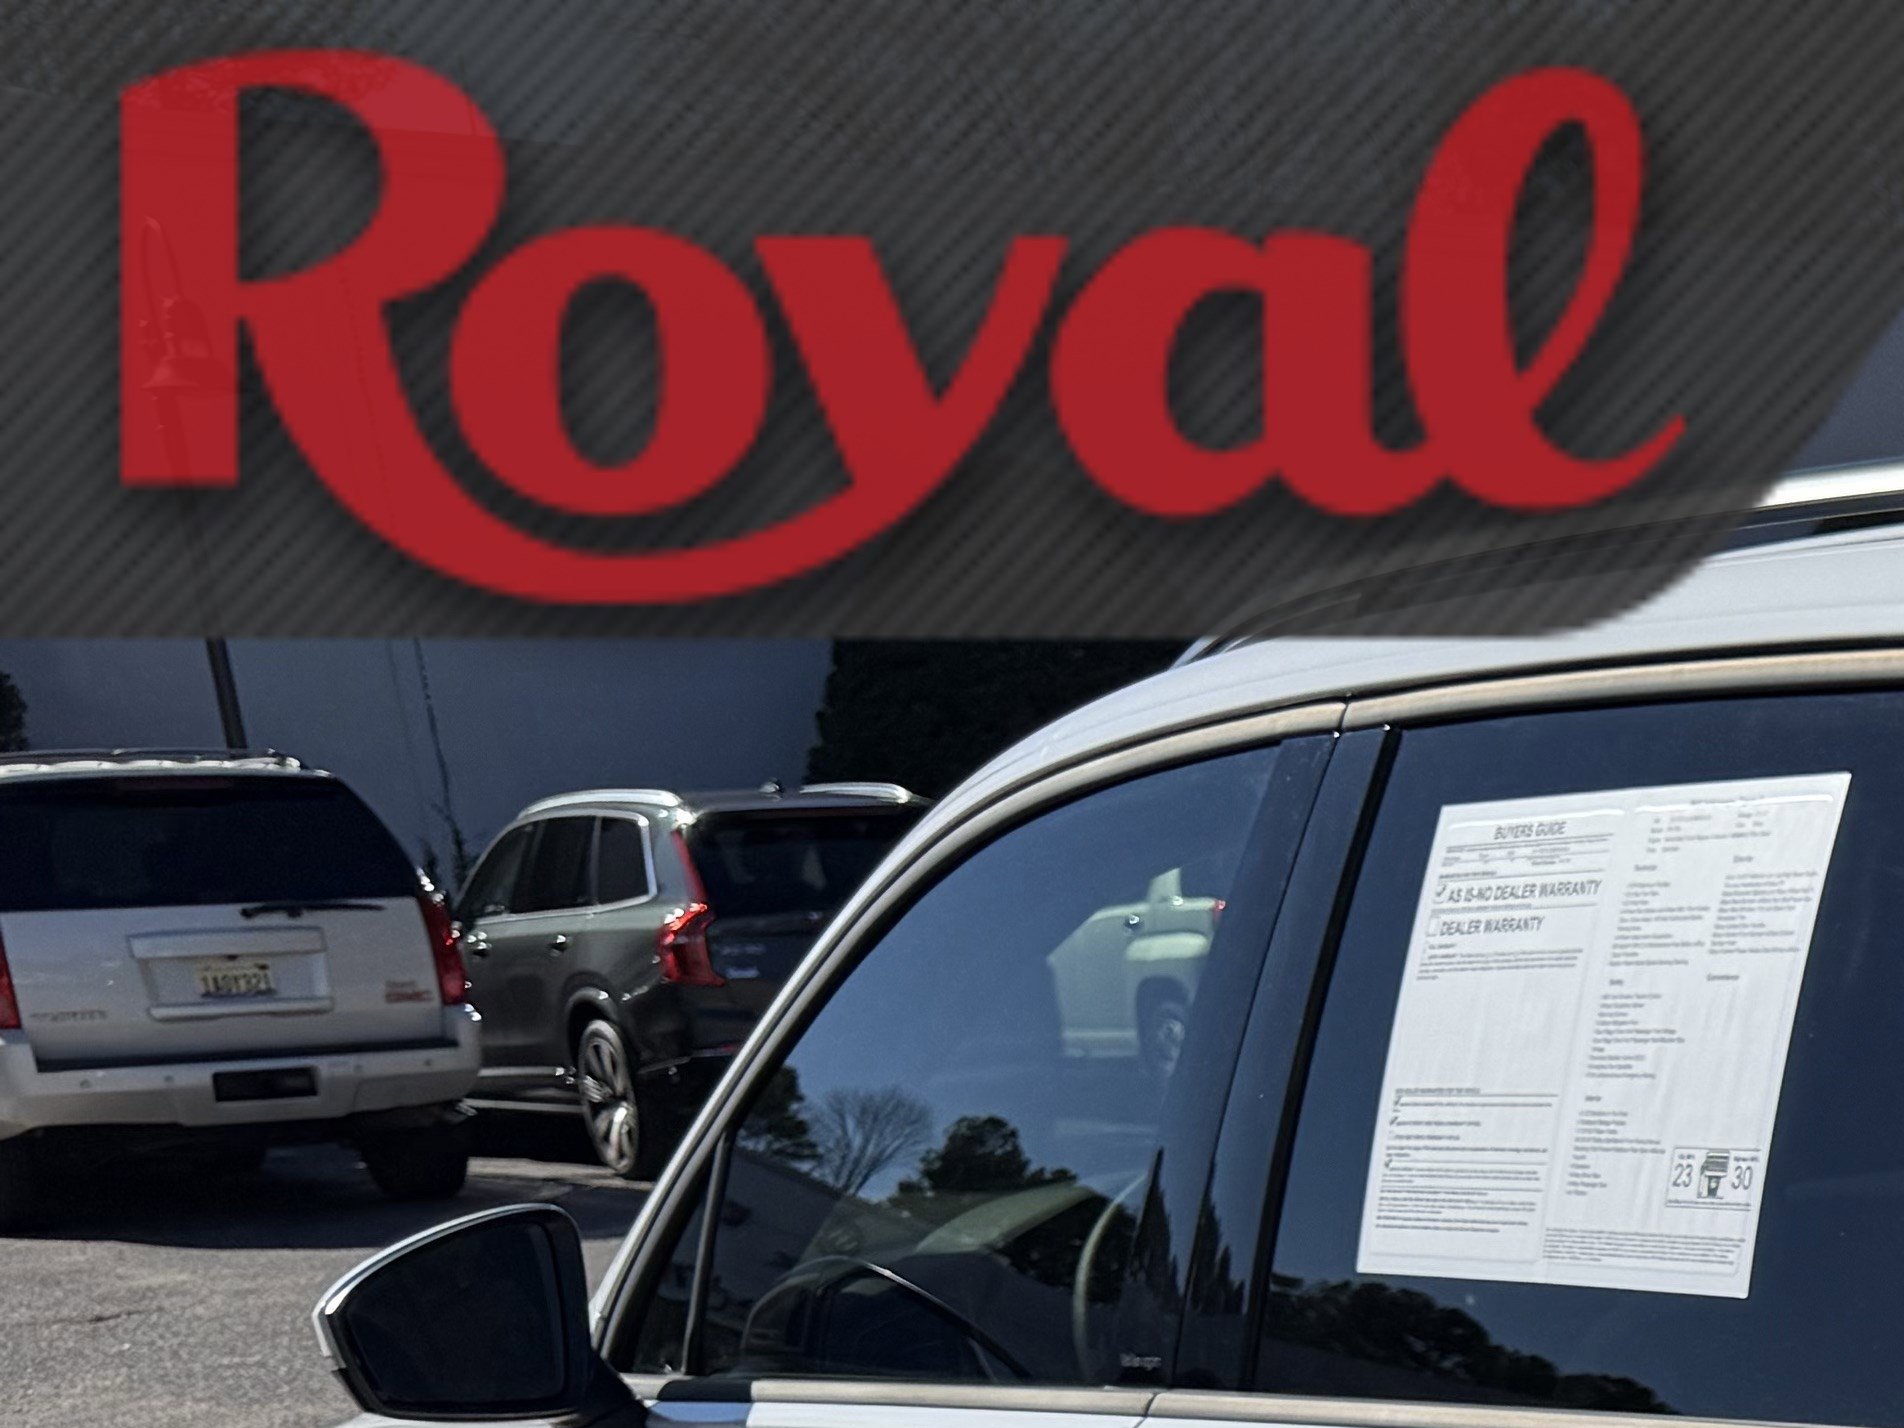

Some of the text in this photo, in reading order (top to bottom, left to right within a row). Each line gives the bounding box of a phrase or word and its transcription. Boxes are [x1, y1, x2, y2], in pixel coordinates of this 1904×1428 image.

[1493, 884, 1537, 901] DEALER
[1539, 880, 1602, 899] WARRANTY
[1440, 916, 1545, 937] DEALER WARRANTY
[1672, 1162, 1694, 1188] 23
[1731, 1165, 1754, 1190] 30
